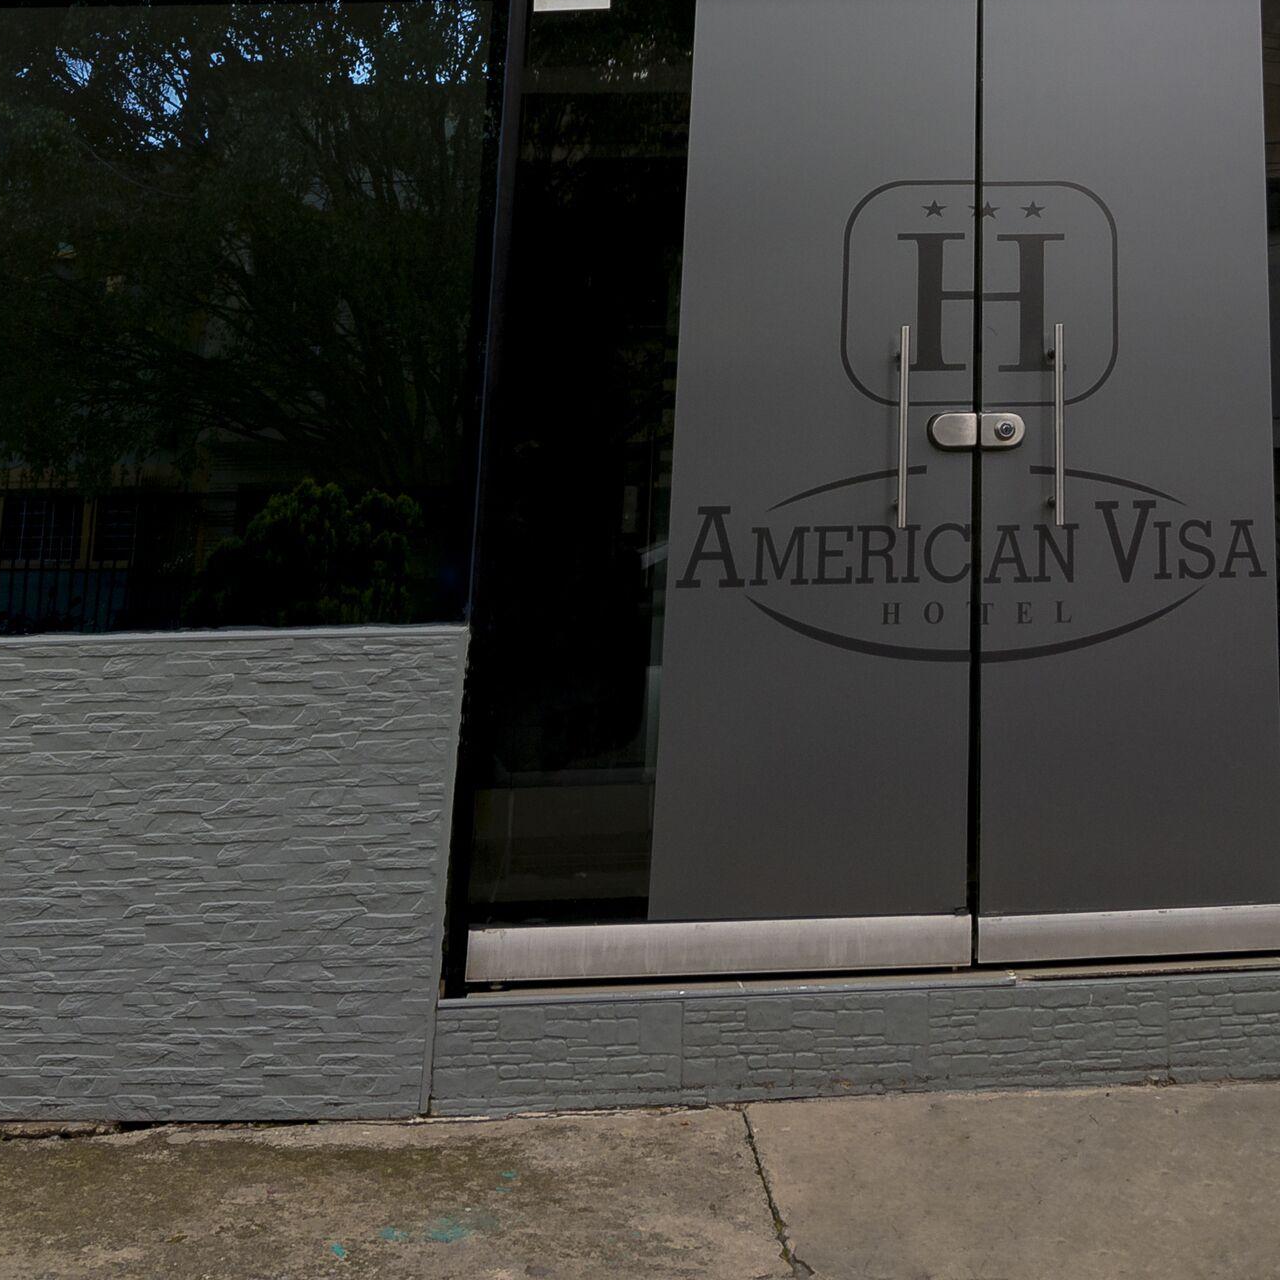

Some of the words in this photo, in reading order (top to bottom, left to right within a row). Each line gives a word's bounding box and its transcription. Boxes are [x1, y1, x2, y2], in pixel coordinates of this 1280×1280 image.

[896, 231, 1068, 372] H
[675, 505, 1080, 588] AMERICAN
[1094, 499, 1268, 583] VISA
[881, 599, 1073, 625] HOTEL
